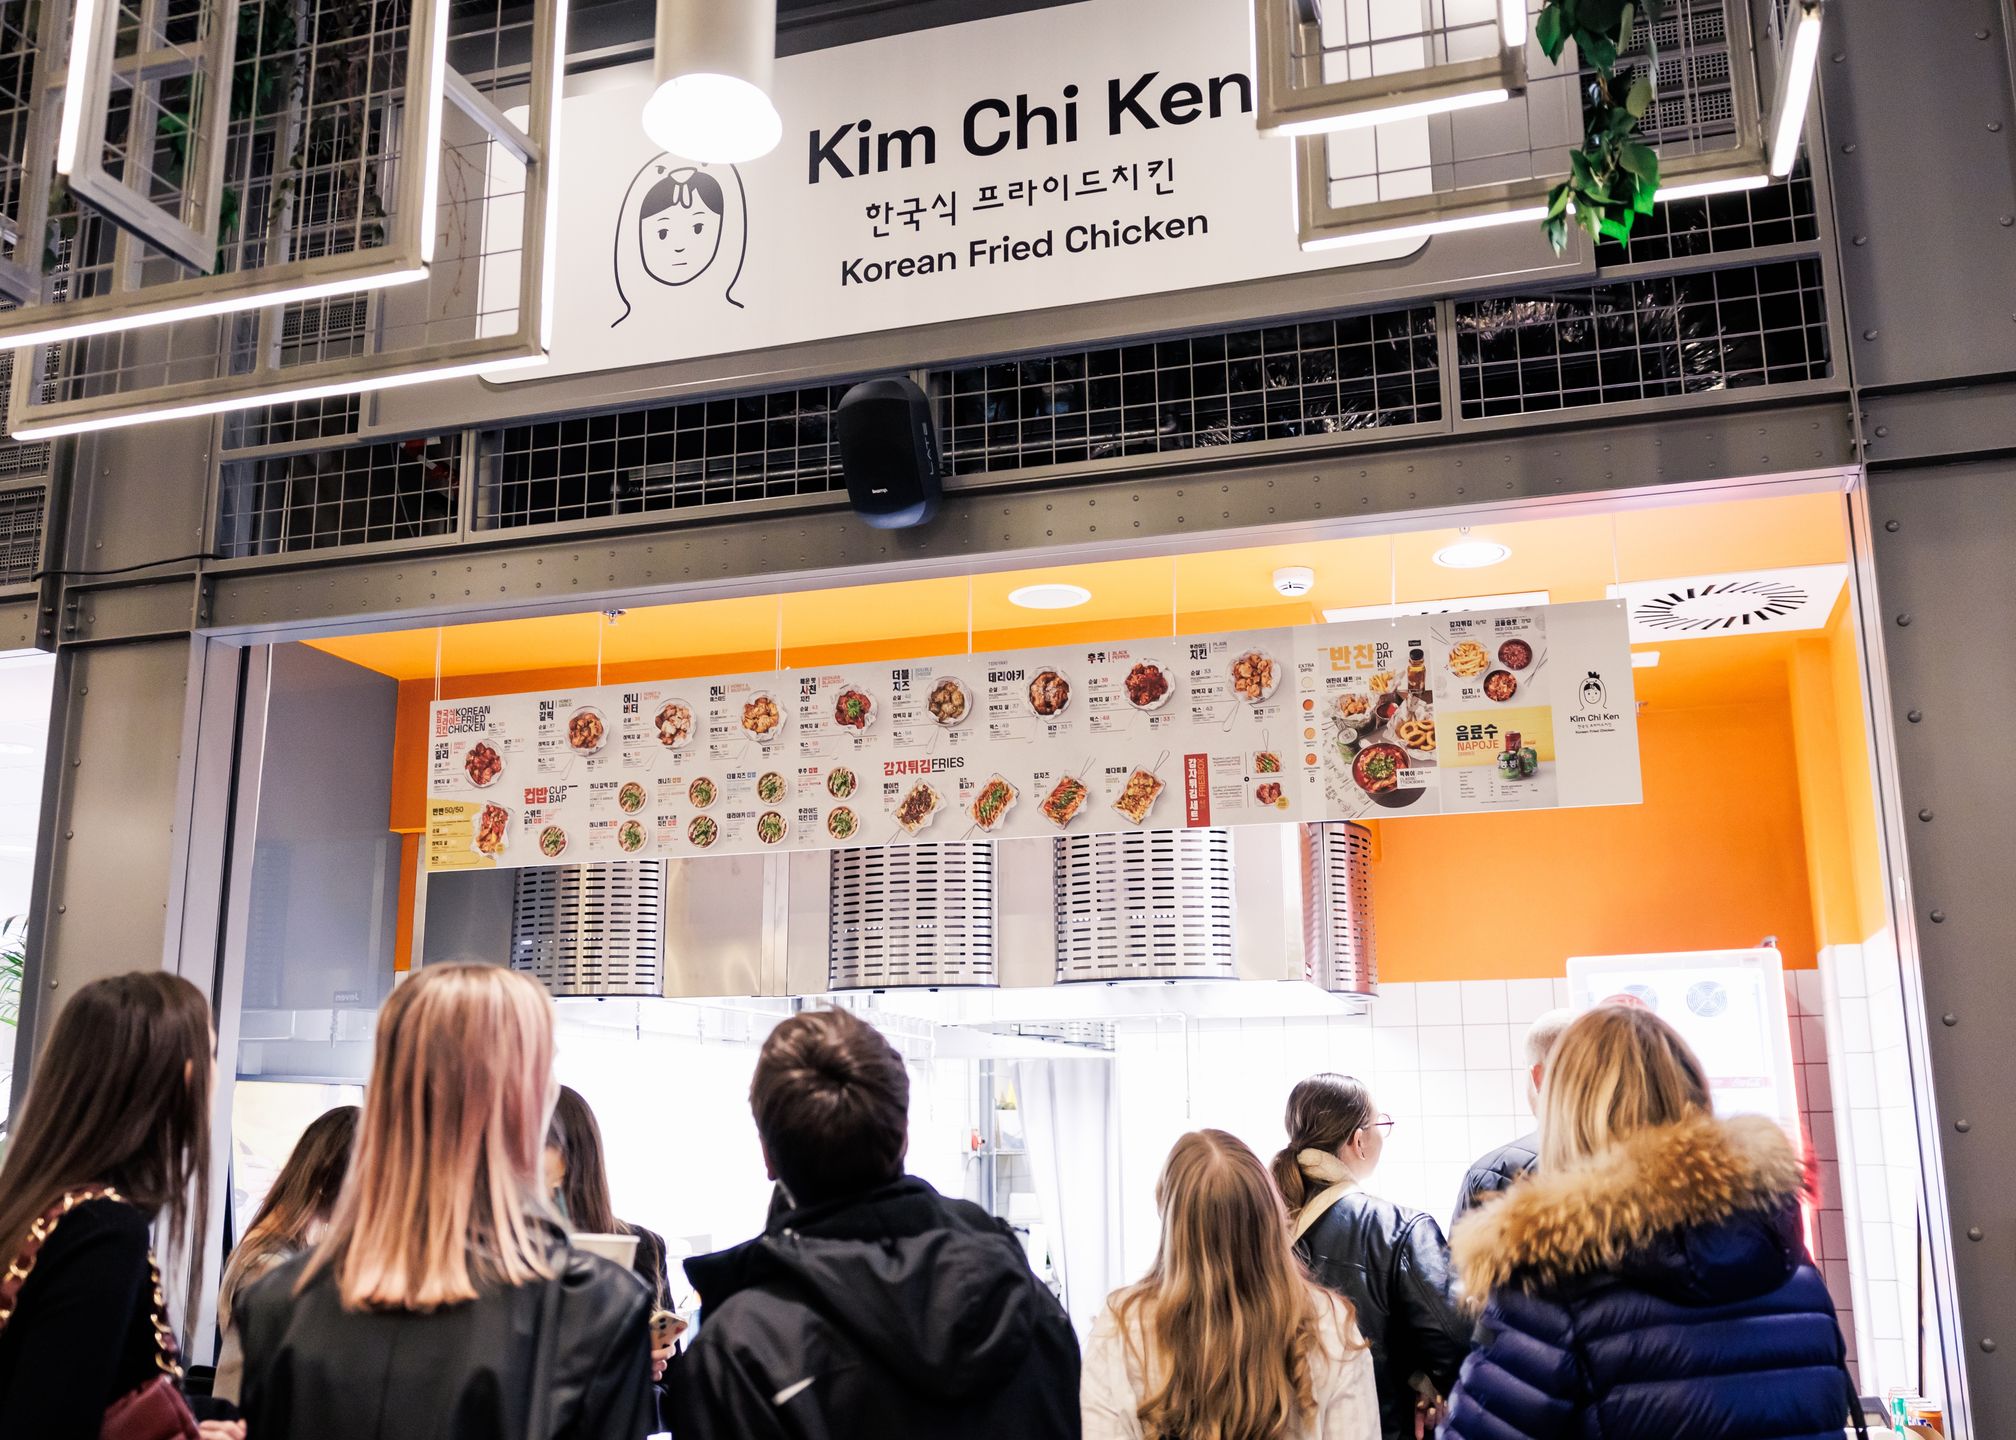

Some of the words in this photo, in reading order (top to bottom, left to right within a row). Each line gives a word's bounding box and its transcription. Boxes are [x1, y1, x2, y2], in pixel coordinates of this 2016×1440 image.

[808, 118, 936, 184] Kim
[963, 84, 1078, 157] Chi
[1107, 71, 1253, 136] Ken
[866, 191, 958, 238] 한국식
[972, 158, 1174, 211] 프라이드치킨
[841, 248, 957, 286] Korean
[969, 229, 1053, 267] Fried
[1065, 214, 1209, 253] Chicken
[1376, 642, 1389, 651] DO
[1088, 652, 1106, 663] 후추
[1190, 649, 1207, 660] 치킨
[1330, 644, 1375, 671] 반찬
[1377, 650, 1394, 659] DAT
[1377, 660, 1386, 668] KI
[892, 669, 909, 680] 더블
[988, 669, 1024, 683] 테리야키
[710, 686, 725, 696] 허니
[800, 684, 816, 695] 사천
[892, 680, 910, 691] 치즈
[624, 693, 638, 703] 허니
[456, 706, 490, 716] KOREAN
[539, 701, 554, 711] 허니
[623, 704, 638, 714] 버터
[461, 715, 486, 724] FRIED
[448, 723, 486, 734] CHICKEN
[1456, 724, 1498, 741] 음료수
[1457, 740, 1500, 751] NAPOJE
[884, 759, 931, 776] 감자튀김
[932, 757, 964, 769] FRIES
[549, 785, 567, 794] CUP
[524, 787, 548, 804] 컵밥
[549, 794, 567, 803] BAP
